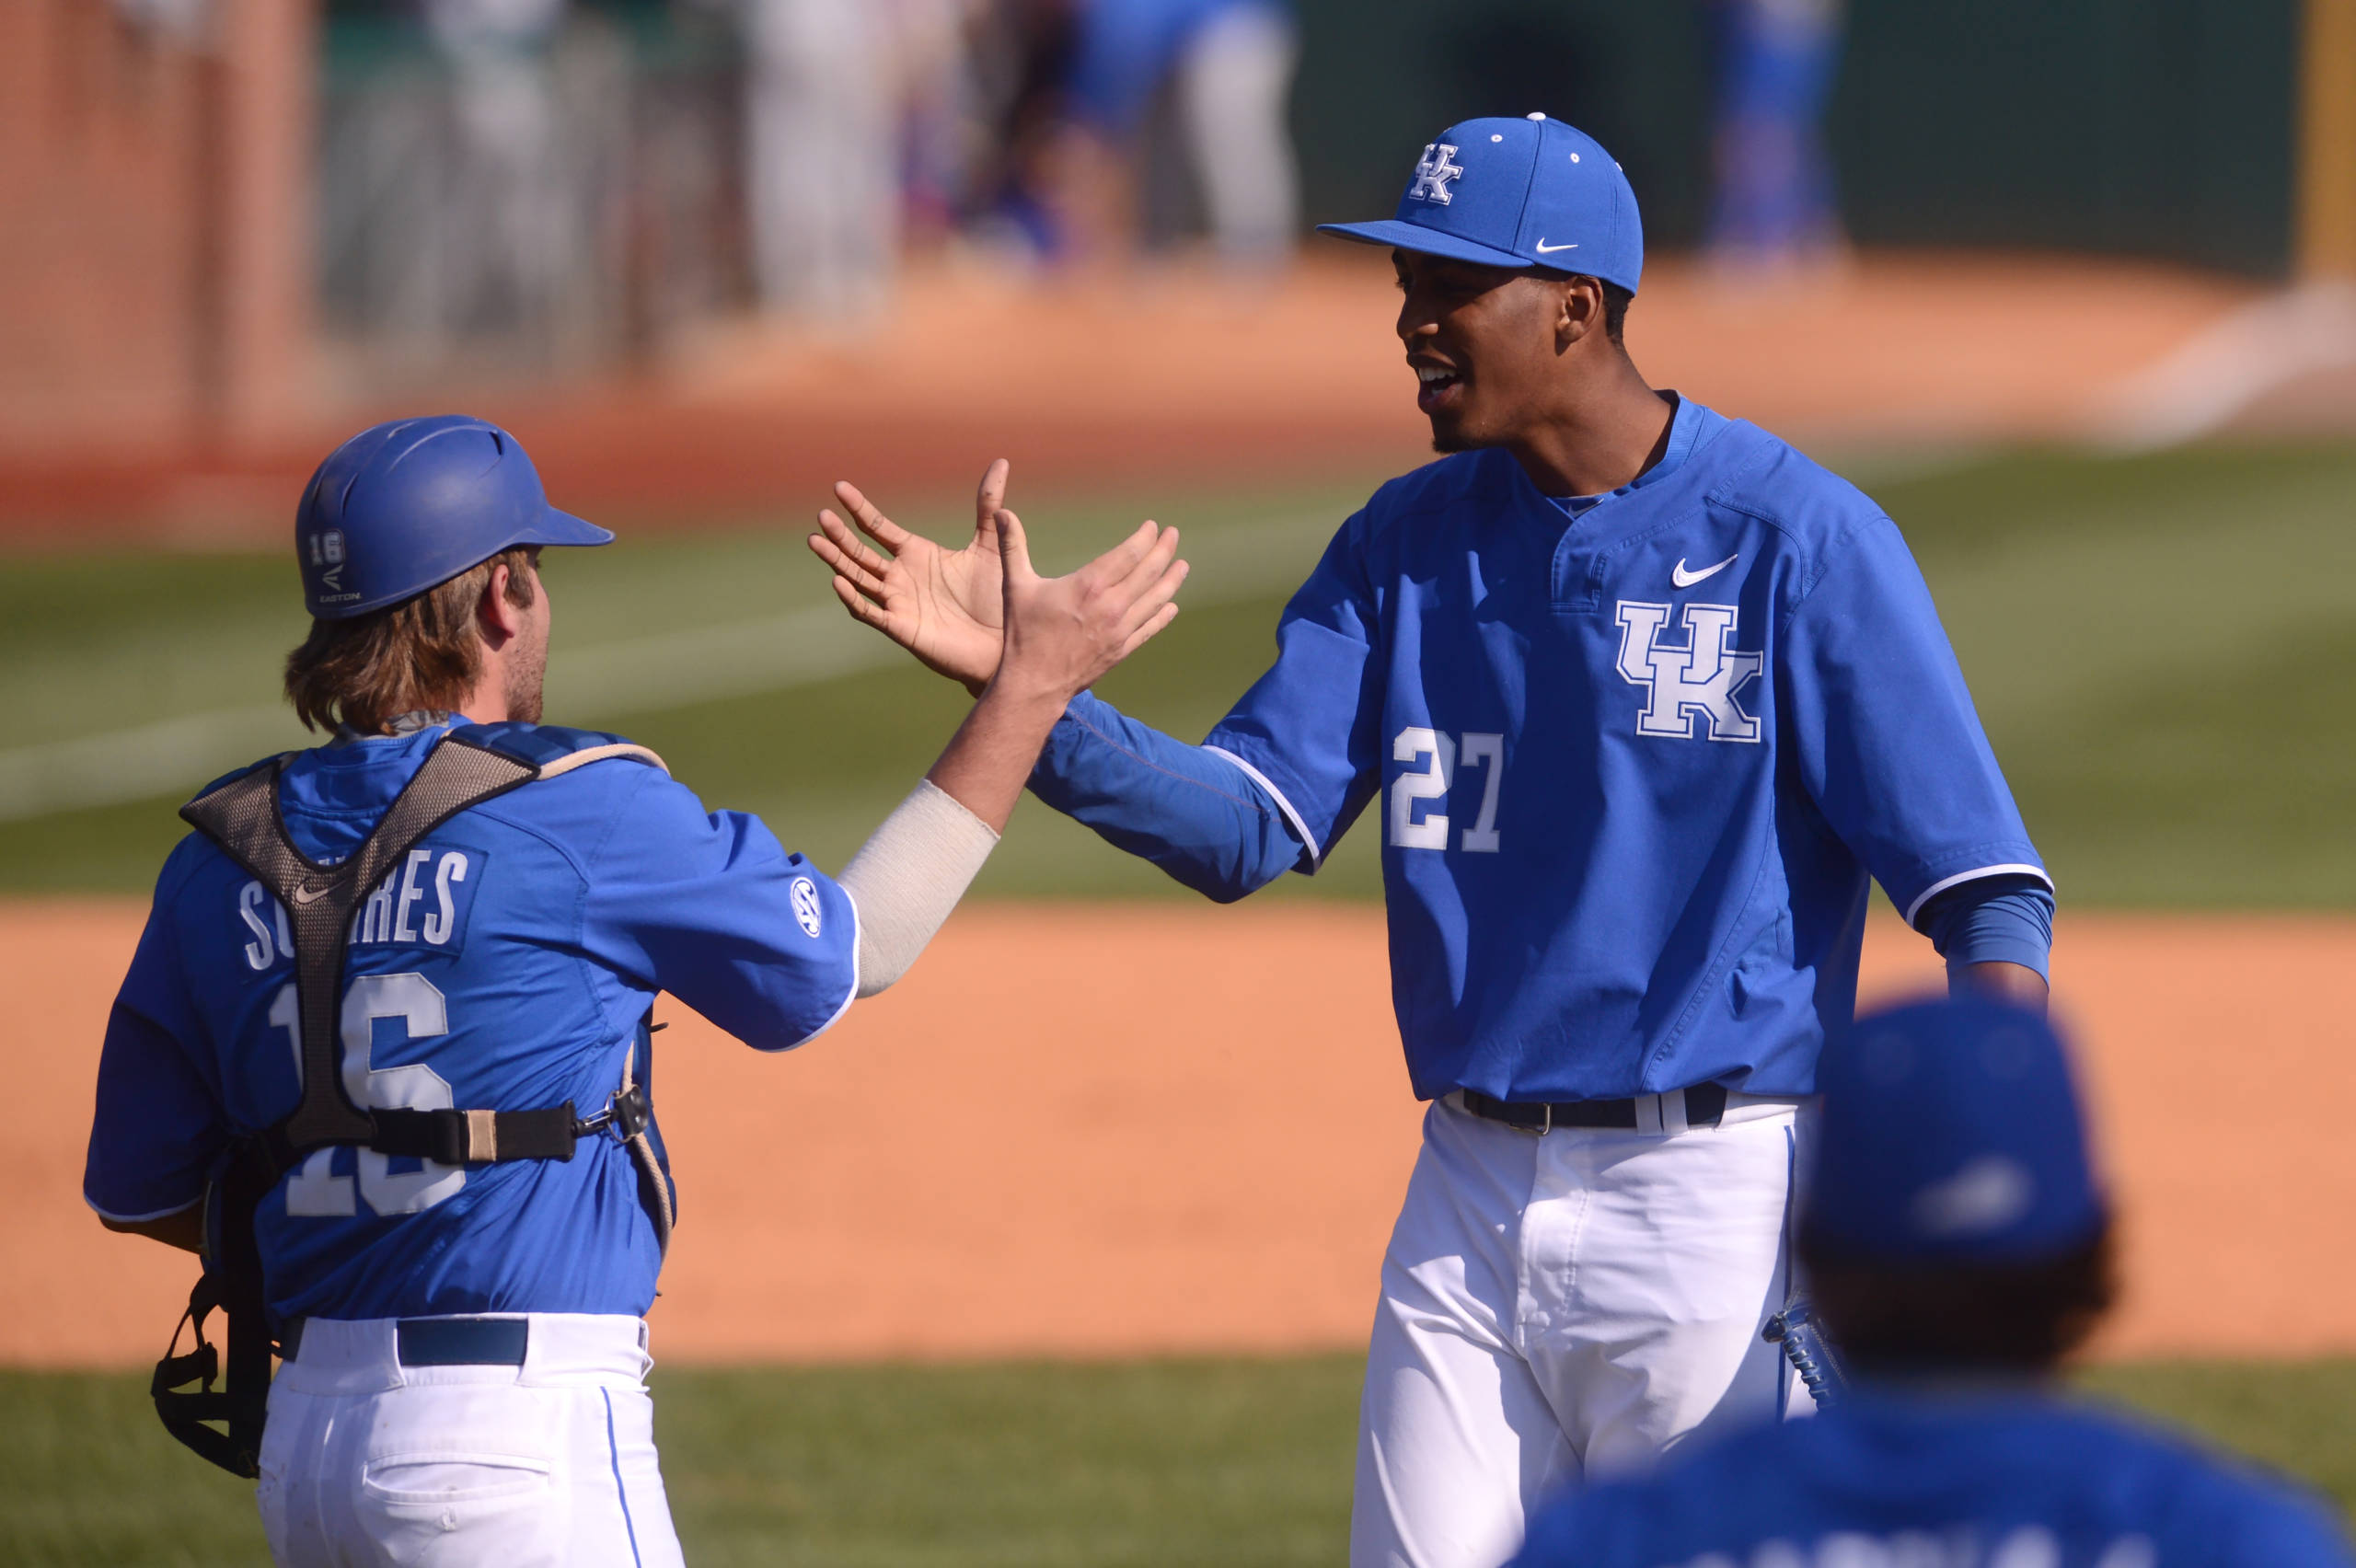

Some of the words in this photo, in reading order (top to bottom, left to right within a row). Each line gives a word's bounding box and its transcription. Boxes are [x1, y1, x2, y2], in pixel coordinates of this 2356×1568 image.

[309, 531, 344, 566] 16
[1390, 727, 1504, 853] 27
[269, 971, 468, 1216] 16
